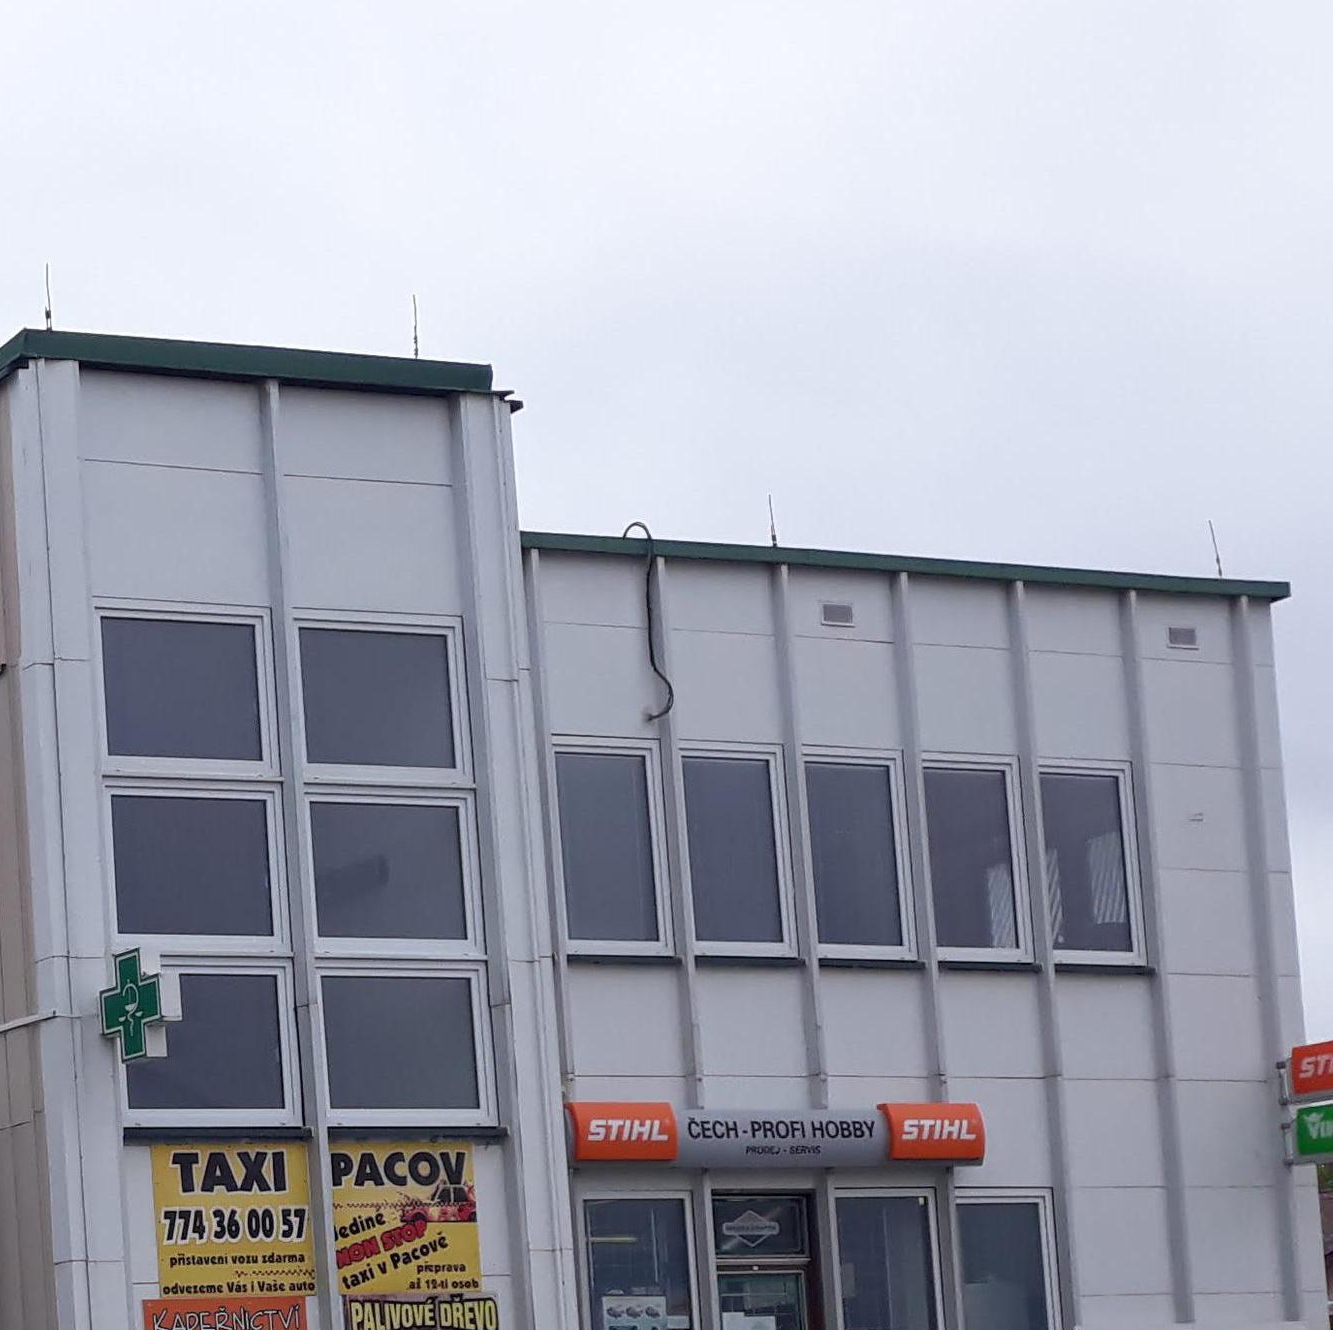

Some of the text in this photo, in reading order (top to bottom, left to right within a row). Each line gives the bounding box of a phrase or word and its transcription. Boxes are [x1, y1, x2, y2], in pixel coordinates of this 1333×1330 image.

[588, 1119, 668, 1142] STIHL
[688, 1117, 738, 1139] ČECH
[752, 1120, 806, 1139] PROFI
[812, 1120, 875, 1139] HOBBY
[901, 1119, 977, 1140] STIHL
[746, 1145, 781, 1155] PRODEJ
[789, 1145, 821, 1155] SERVIS
[171, 1151, 287, 1193] TAXI
[331, 1151, 466, 1187] PACOV
[163, 1207, 306, 1242] 774 36 00 57
[336, 1219, 427, 1269] NON STOP
[232, 1254, 259, 1265] vozu
[262, 1252, 305, 1264] zdarma
[342, 1231, 448, 1290] taxi v Pacově
[417, 1260, 466, 1275] přeprava
[163, 1283, 224, 1295] odvezeme
[227, 1281, 247, 1293] Vás
[257, 1280, 285, 1293] Vaše
[289, 1281, 316, 1292] auto
[452, 1279, 479, 1289] osob
